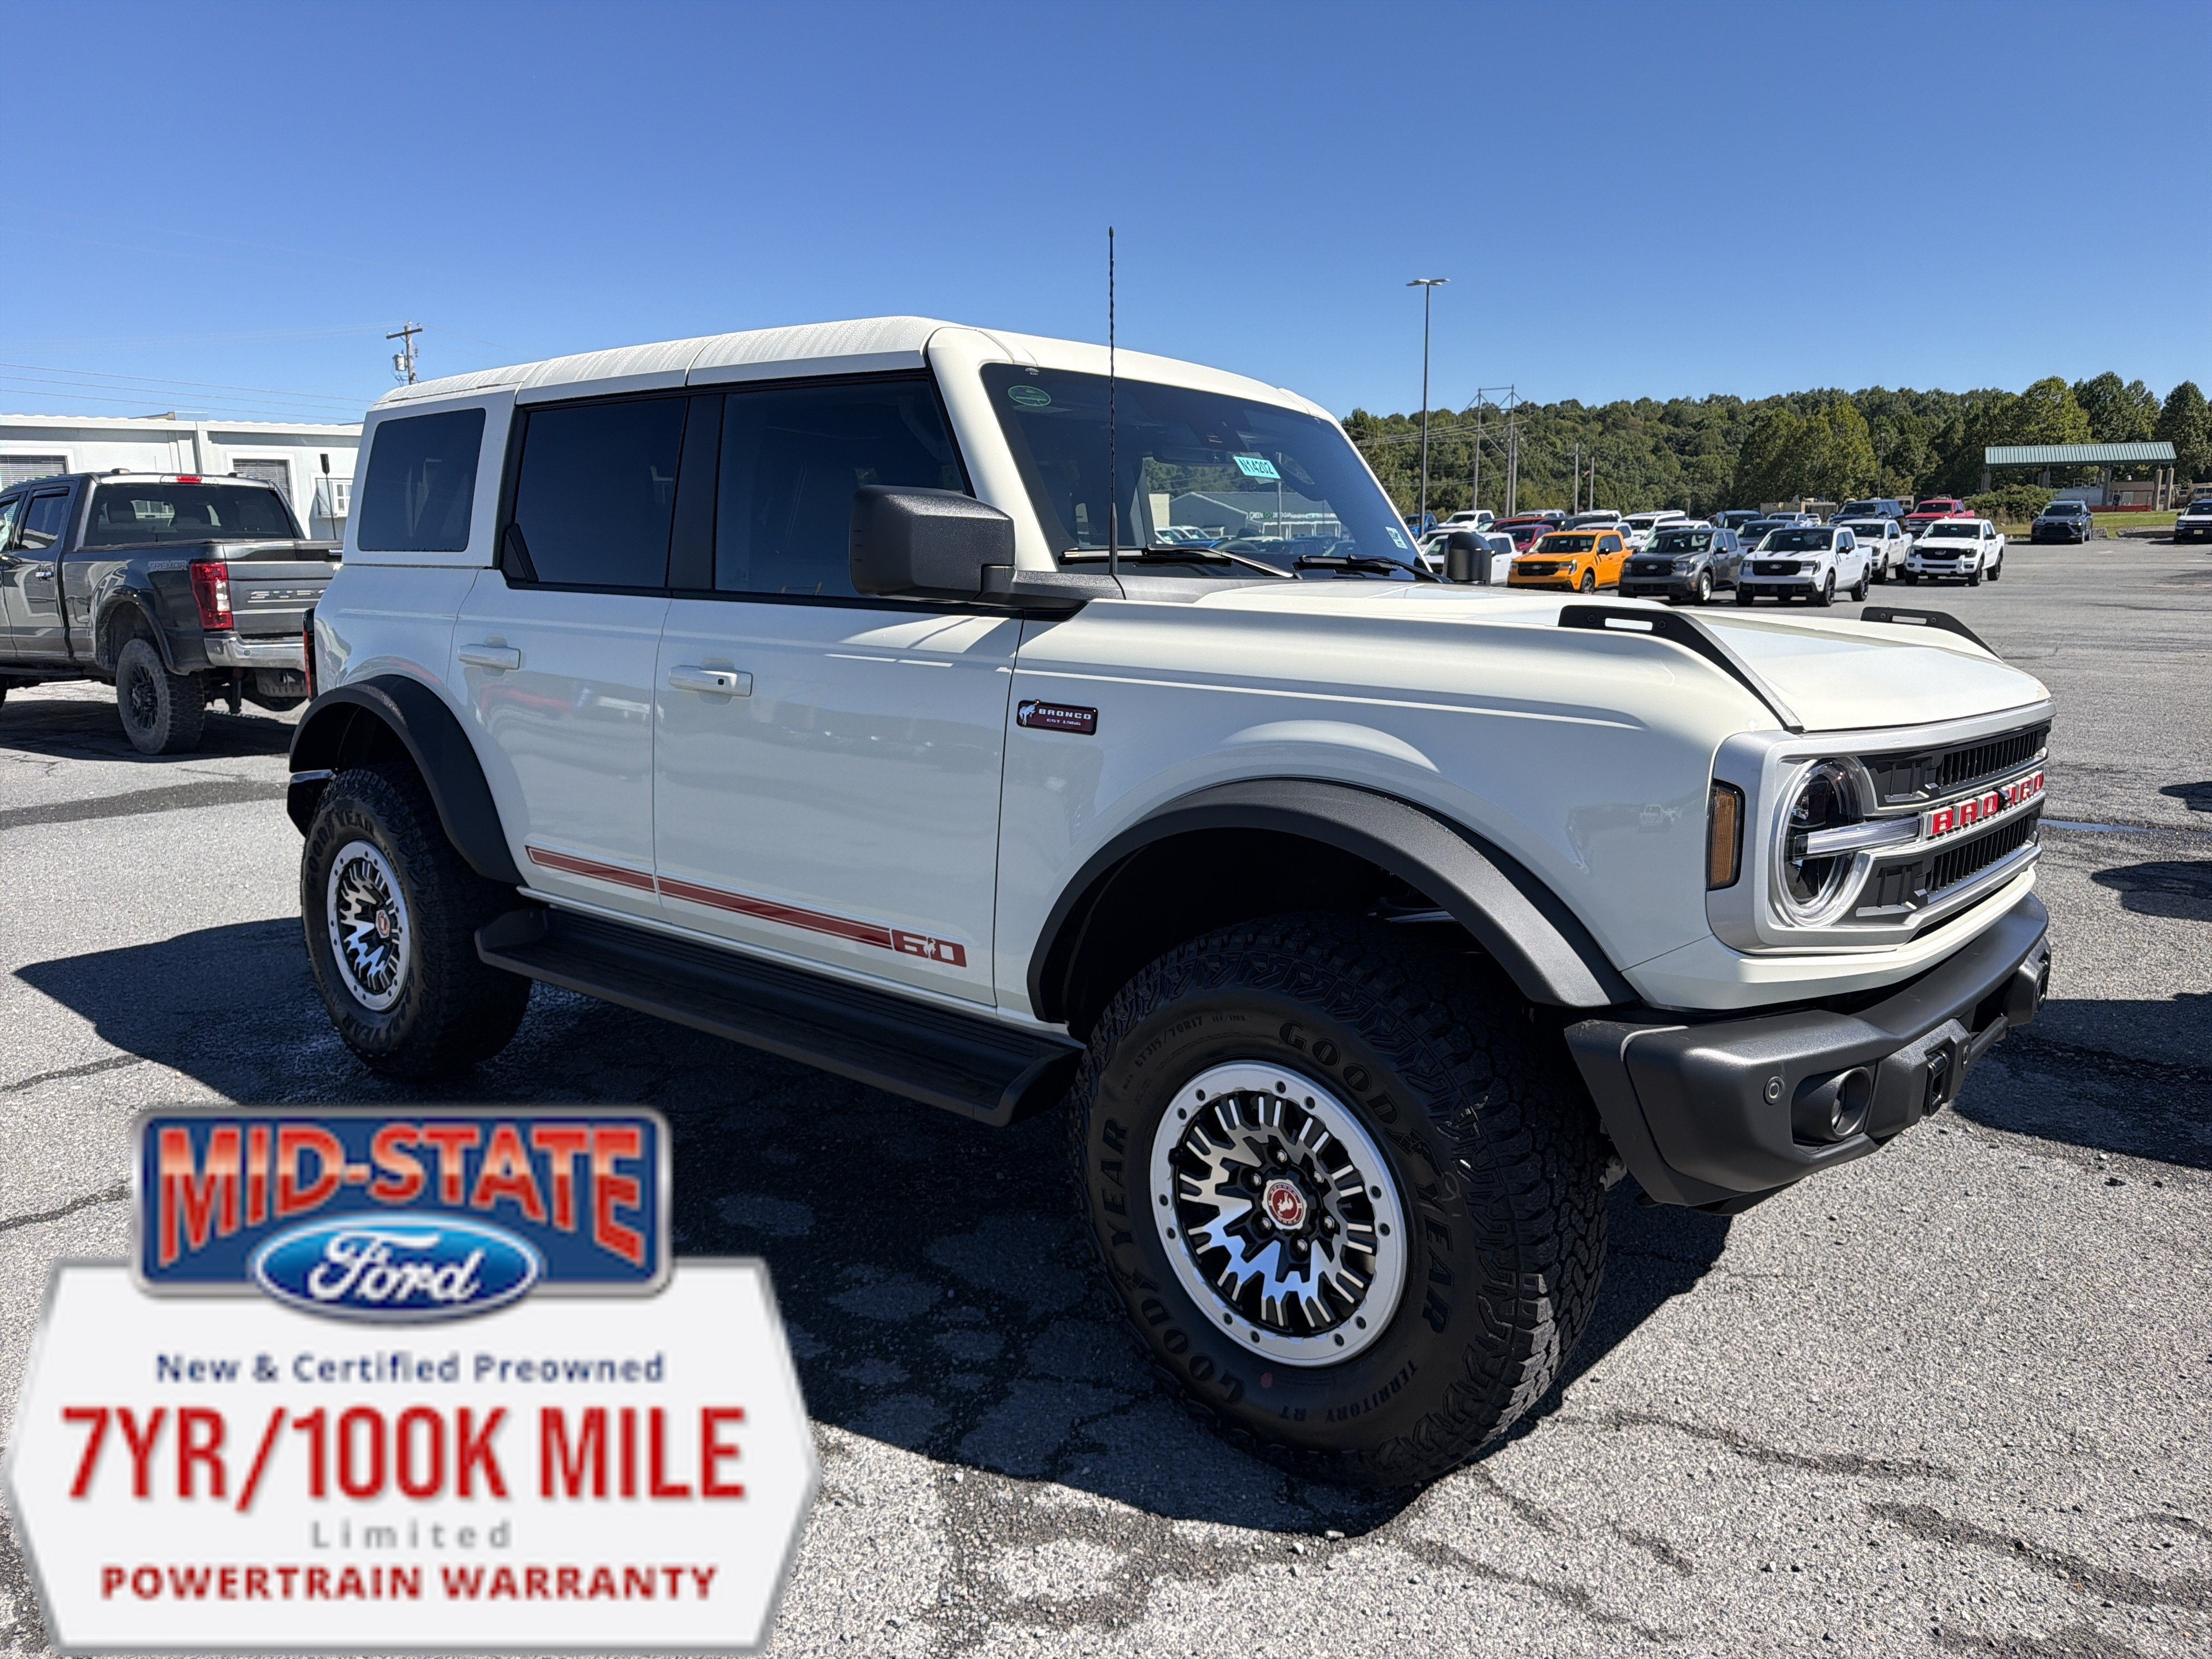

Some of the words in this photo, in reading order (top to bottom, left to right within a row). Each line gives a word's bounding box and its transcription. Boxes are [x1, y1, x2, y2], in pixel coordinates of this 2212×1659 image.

[1238, 458, 1274, 475] N14202
[1039, 708, 1092, 720] BRONCO
[1325, 1359, 1418, 1422] TERRITORY
